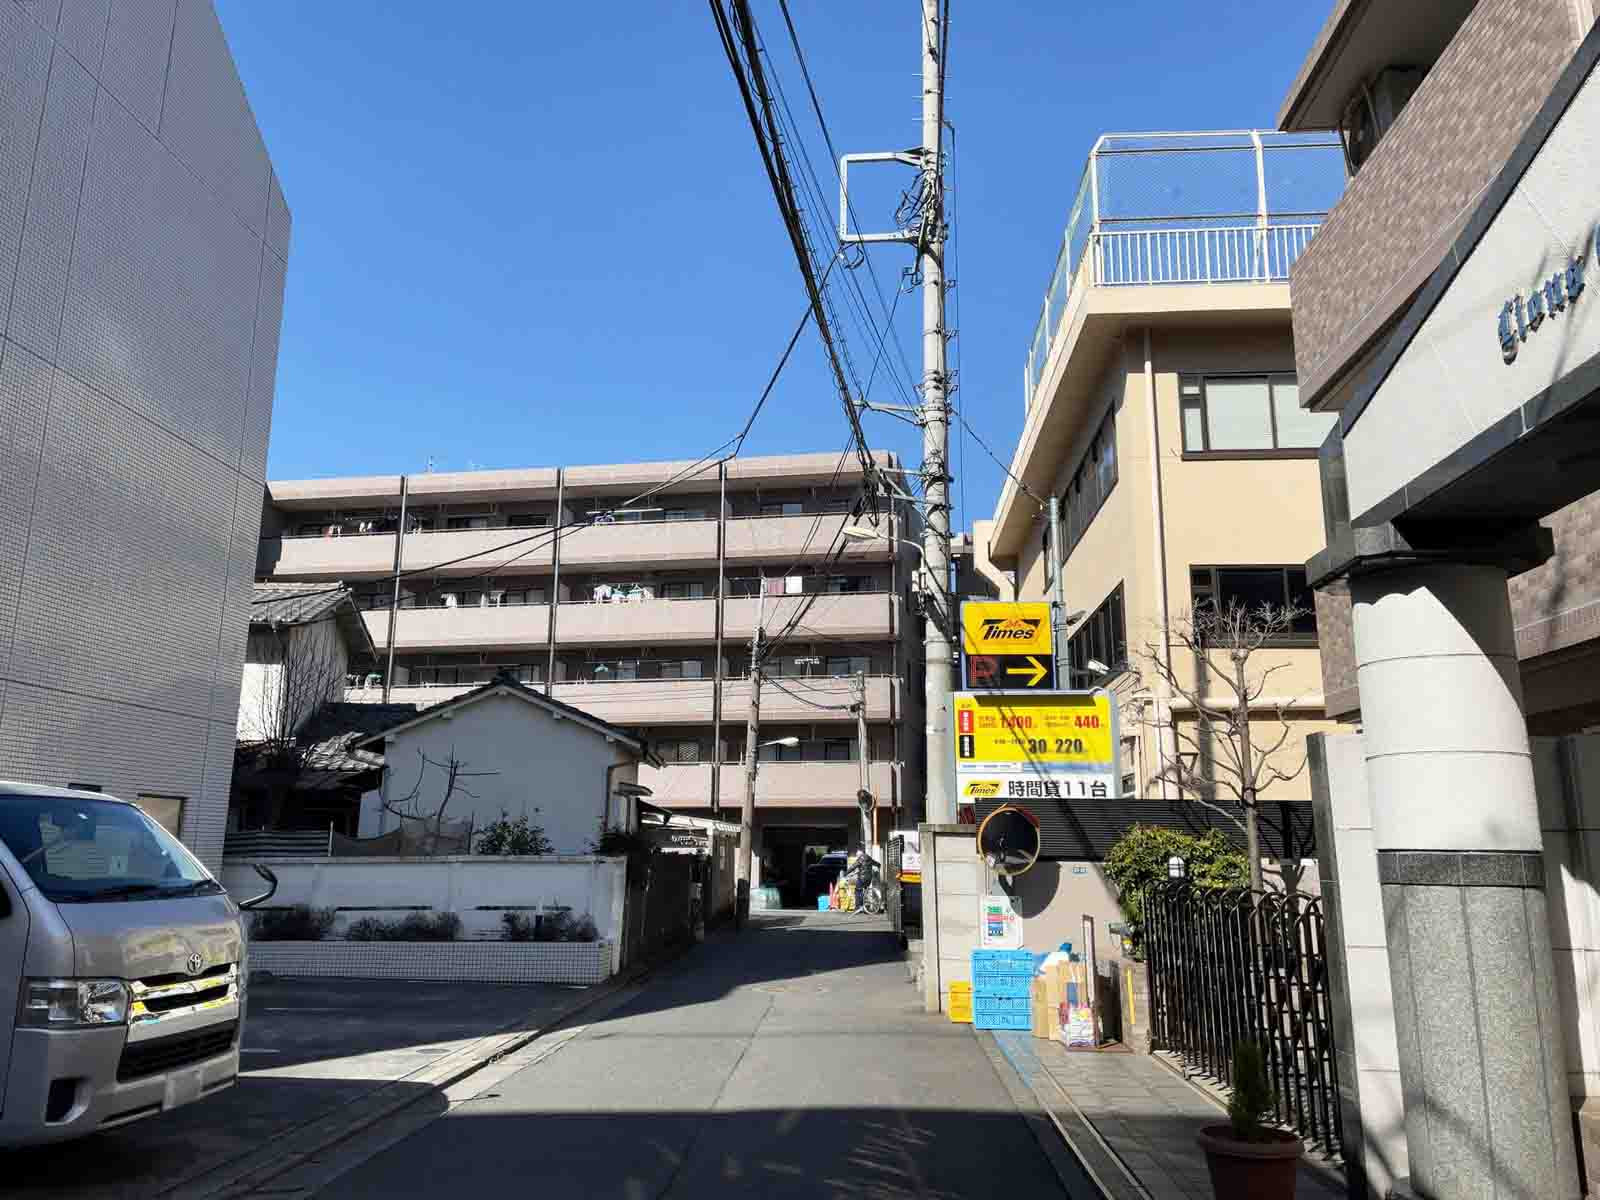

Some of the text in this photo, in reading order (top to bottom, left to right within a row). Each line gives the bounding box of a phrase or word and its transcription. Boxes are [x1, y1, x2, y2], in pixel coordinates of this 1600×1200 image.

[979, 618, 1040, 641] Times
[1074, 715, 1100, 729] 440
[1028, 738, 1048, 754] 30
[1055, 738, 1083, 754] 220
[969, 783, 1000, 796] Times
[1008, 780, 1107, 798] 時間貸11台
